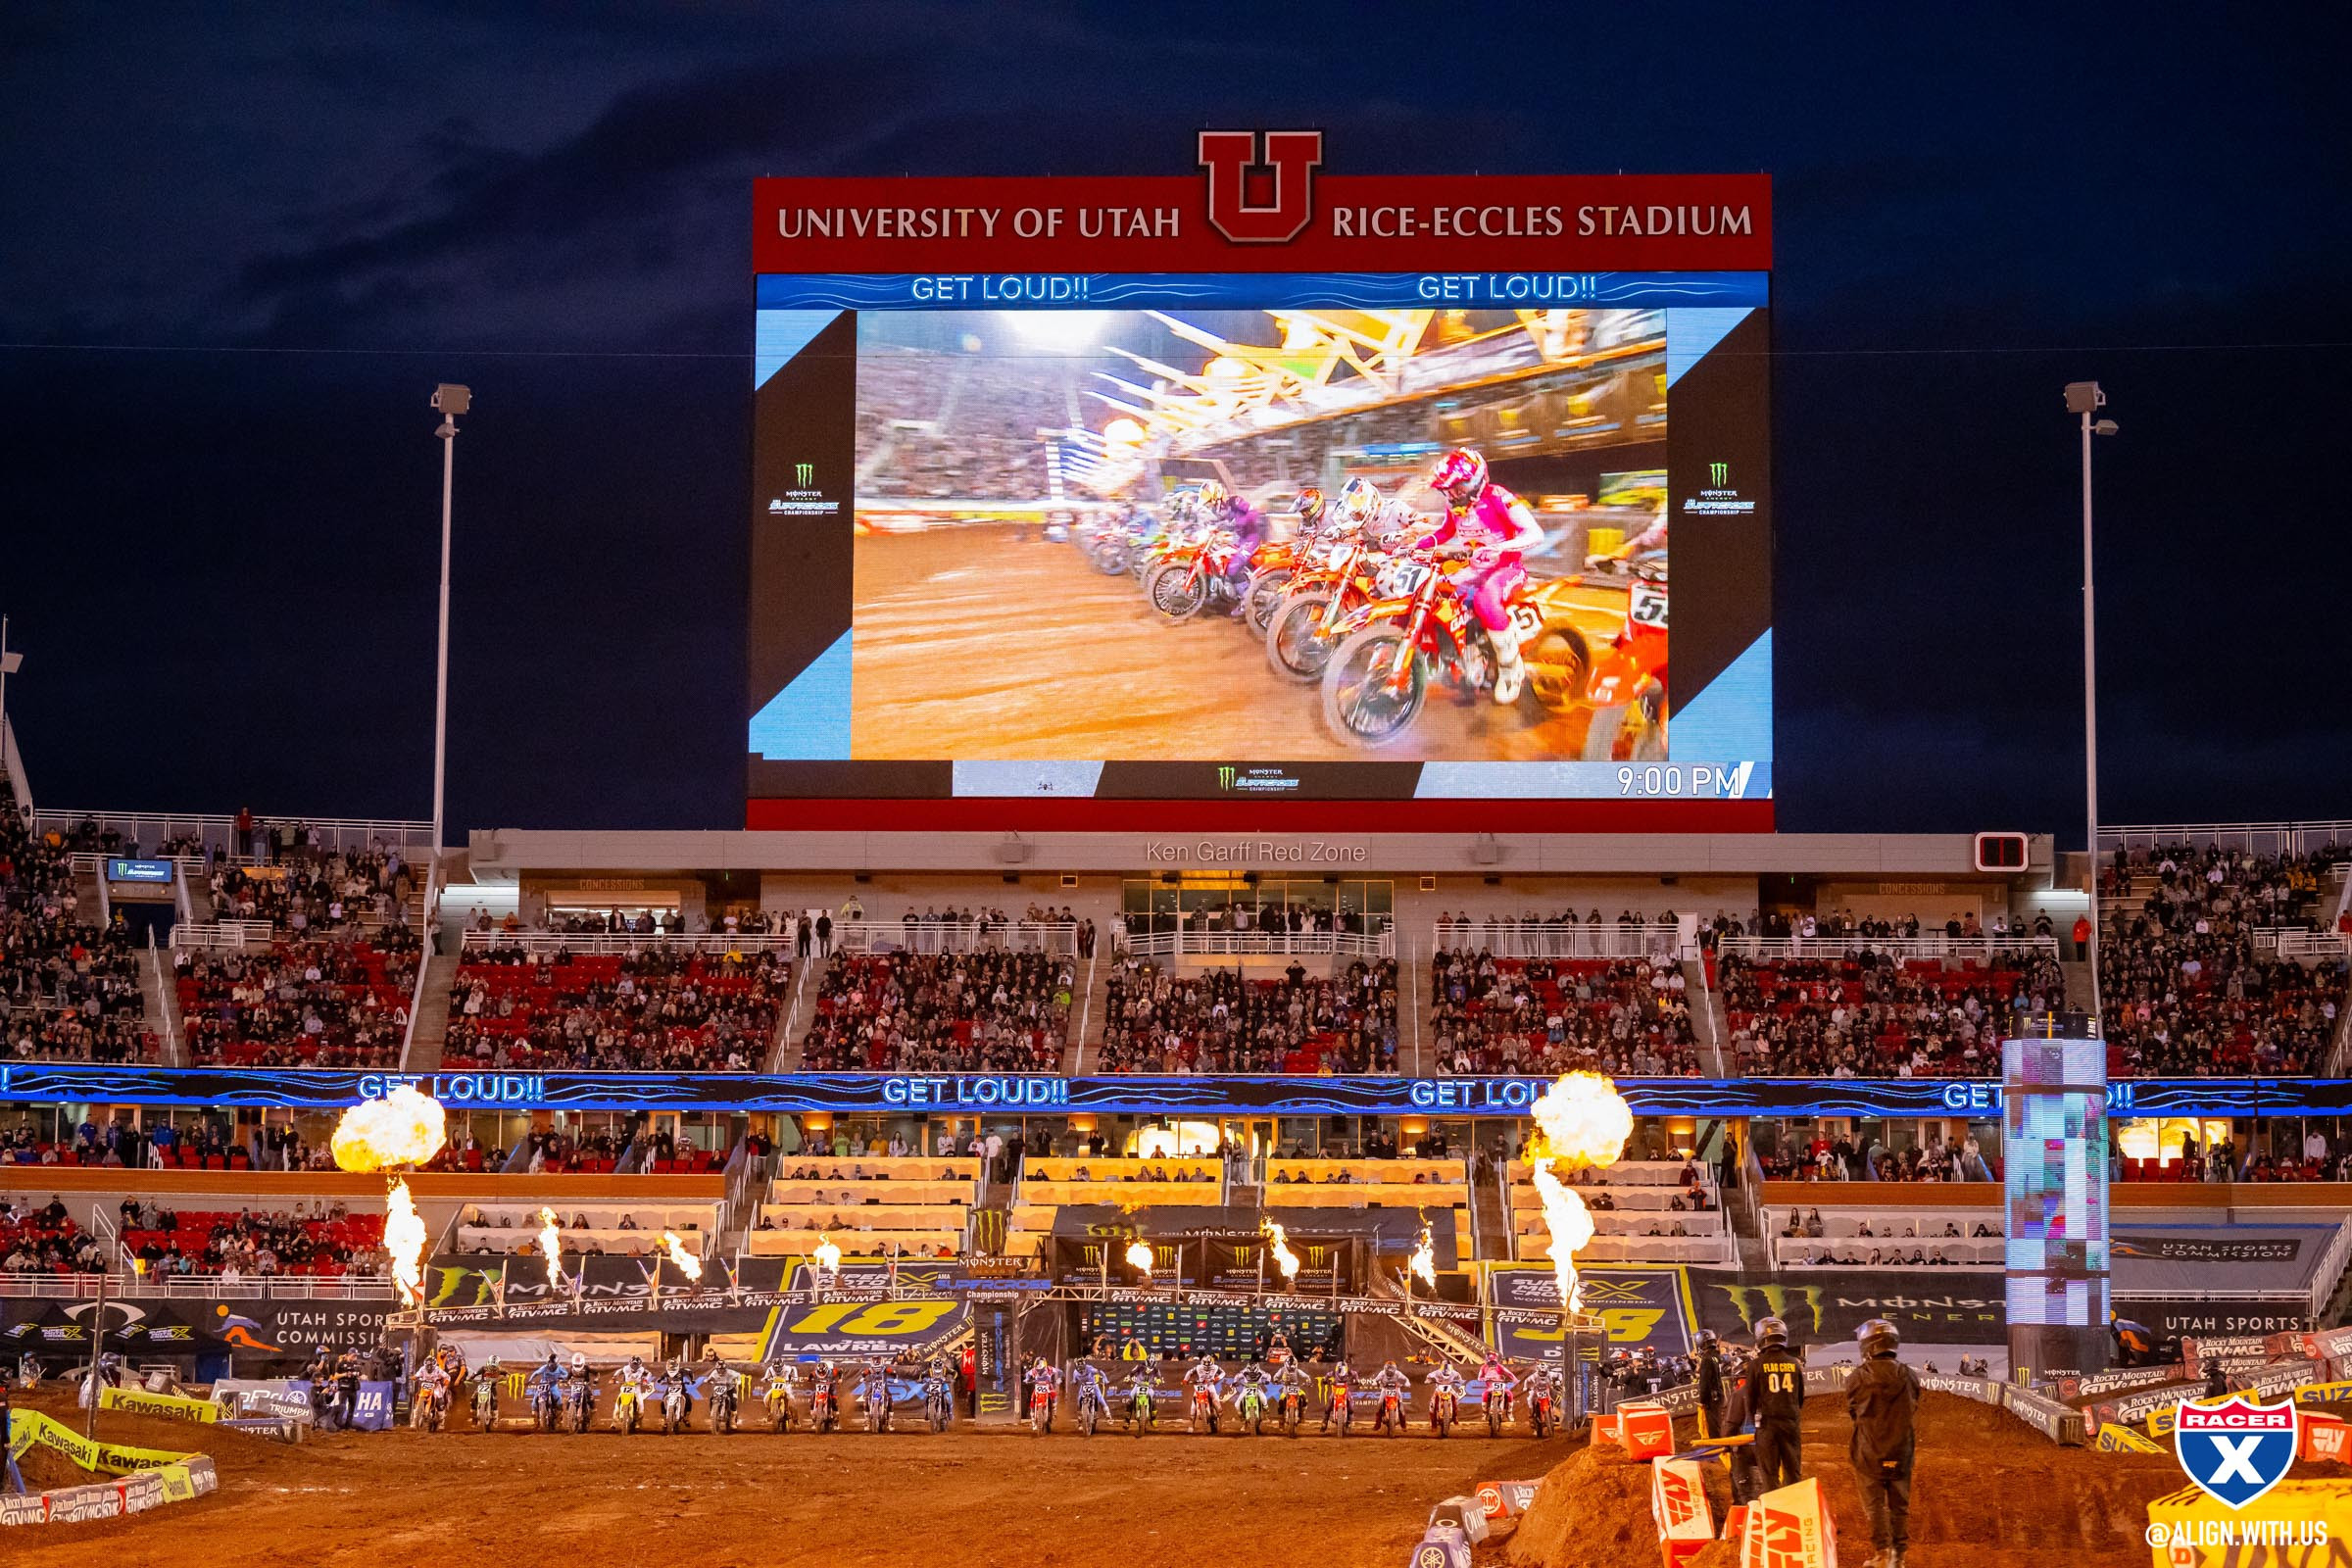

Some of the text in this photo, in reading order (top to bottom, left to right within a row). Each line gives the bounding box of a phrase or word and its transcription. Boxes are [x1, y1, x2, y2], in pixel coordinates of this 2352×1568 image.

[1198, 130, 1323, 242] U
[777, 207, 1181, 238] UNIVERSITY OF UTAH
[1333, 205, 1753, 237] RICE-ECCLES STADIUM
[911, 276, 1090, 302] GET LOUD!!
[1417, 275, 1598, 301] GET LOUD!!
[1394, 566, 1424, 593] 51
[1635, 593, 1669, 624] 5
[1617, 765, 1740, 796] 9:00 PM
[1146, 841, 1366, 861] Ken Garff Red Zone
[579, 879, 646, 892] CONCESSIONS
[1879, 882, 1945, 895] CONCESSIONS
[433, 1075, 545, 1102] LOUD!!
[884, 1078, 1069, 1104] GET LOUD!!
[1411, 1081, 1476, 1106] GET
[1942, 1083, 2004, 1108] GET
[2161, 1250, 2289, 1258] COMMISSION
[2162, 1243, 2212, 1251] UTAH
[958, 1256, 1023, 1269] MONSTER
[966, 1290, 1019, 1299] Championship
[1836, 1295, 2006, 1309] MONST
[276, 1312, 384, 1327] UTAH SPOR
[789, 1300, 958, 1336] 18
[1882, 1312, 1996, 1322] ENER
[2165, 1316, 2299, 1331] UTAH SPORTS
[275, 1330, 375, 1345] COMMISSI
[784, 1343, 925, 1351] LAWREN
[922, 1323, 966, 1354] MONSTER
[1445, 1323, 1488, 1354] MONSTER
[2205, 1338, 2228, 1348] ROCKY
[2228, 1337, 2263, 1347] MOUNTAIN
[1763, 1363, 1795, 1373] FLAG CREW
[2044, 1368, 2082, 1377] MONSTER
[2092, 1370, 2166, 1384] ROCKY MOUNTAIN
[1768, 1373, 1793, 1394] 04
[1920, 1376, 1982, 1395] MONSTER
[1648, 1389, 1700, 1406] ONSTE
[2131, 1386, 2206, 1408] ROCKY MOUNTAIN
[2302, 1387, 2352, 1402] SUZ
[111, 1394, 204, 1422] Kawasaki
[270, 1403, 311, 1416] TRIUMPH
[2013, 1398, 2047, 1425] MONSTER
[239, 1426, 278, 1436] NSTER
[39, 1422, 92, 1465] Kawasaki
[98, 1448, 177, 1469] Kawas
[1805, 1518, 1818, 1568] ACING
